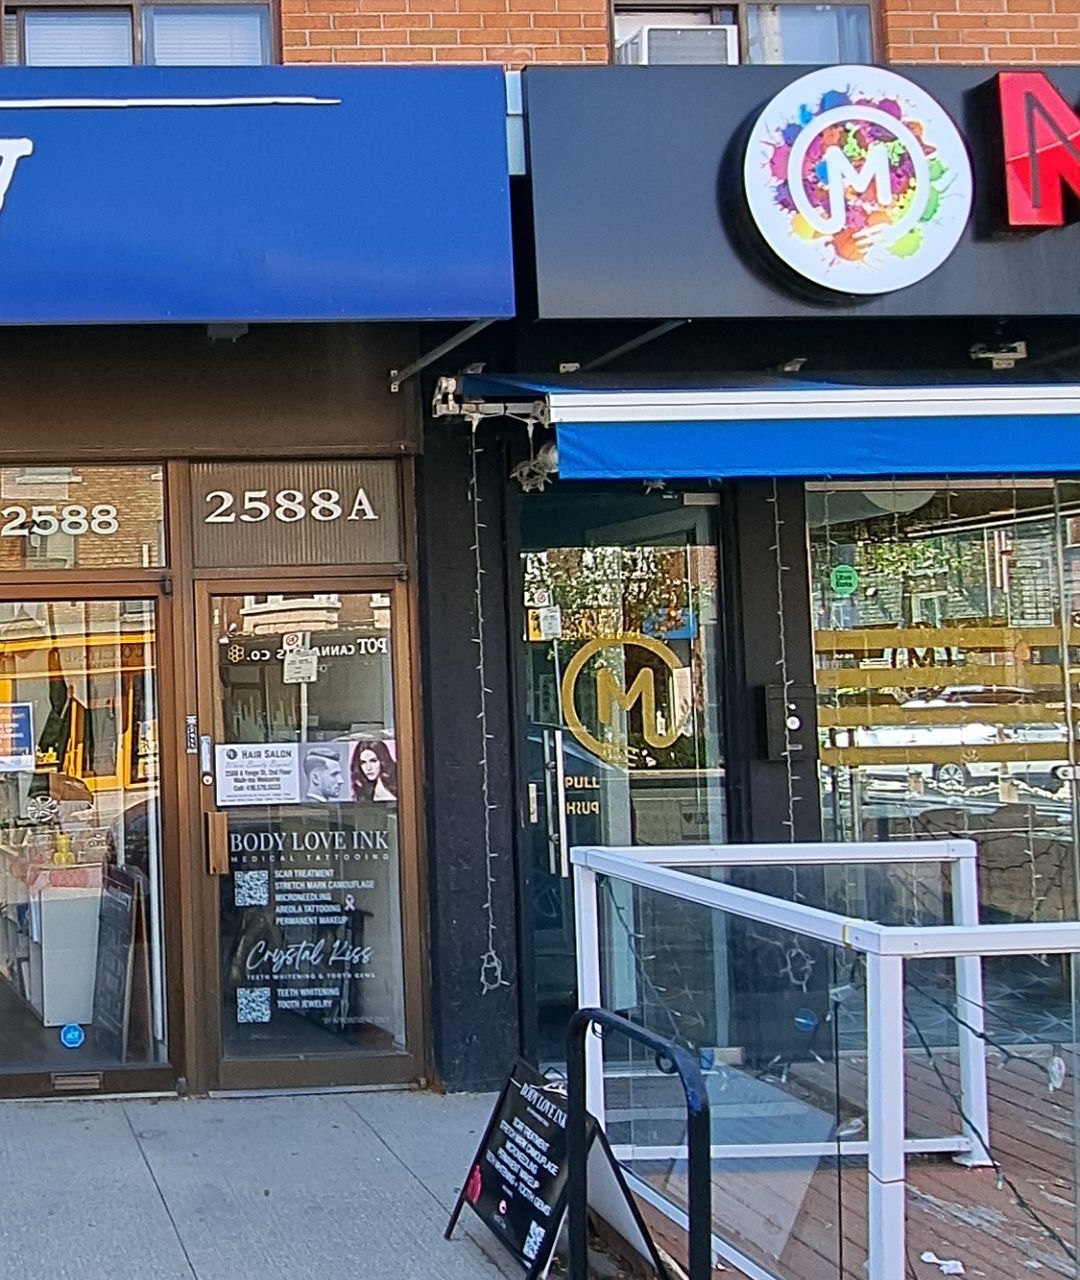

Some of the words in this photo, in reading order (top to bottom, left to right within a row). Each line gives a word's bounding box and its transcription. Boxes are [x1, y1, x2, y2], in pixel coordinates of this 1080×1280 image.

[204, 488, 379, 523] 2588A
[0, 504, 120, 537] 2588
[241, 750, 262, 759] HAIR
[264, 749, 292, 758] SALON
[564, 777, 600, 789] PULL
[230, 832, 287, 852] BODY
[291, 831, 346, 851] LOVE
[352, 830, 389, 850] INK
[231, 855, 295, 863] MEDICAL
[306, 853, 390, 862] TATTOOING
[274, 881, 306, 890] STRETCH
[246, 938, 326, 973] Crystal
[328, 939, 375, 966] Kiss
